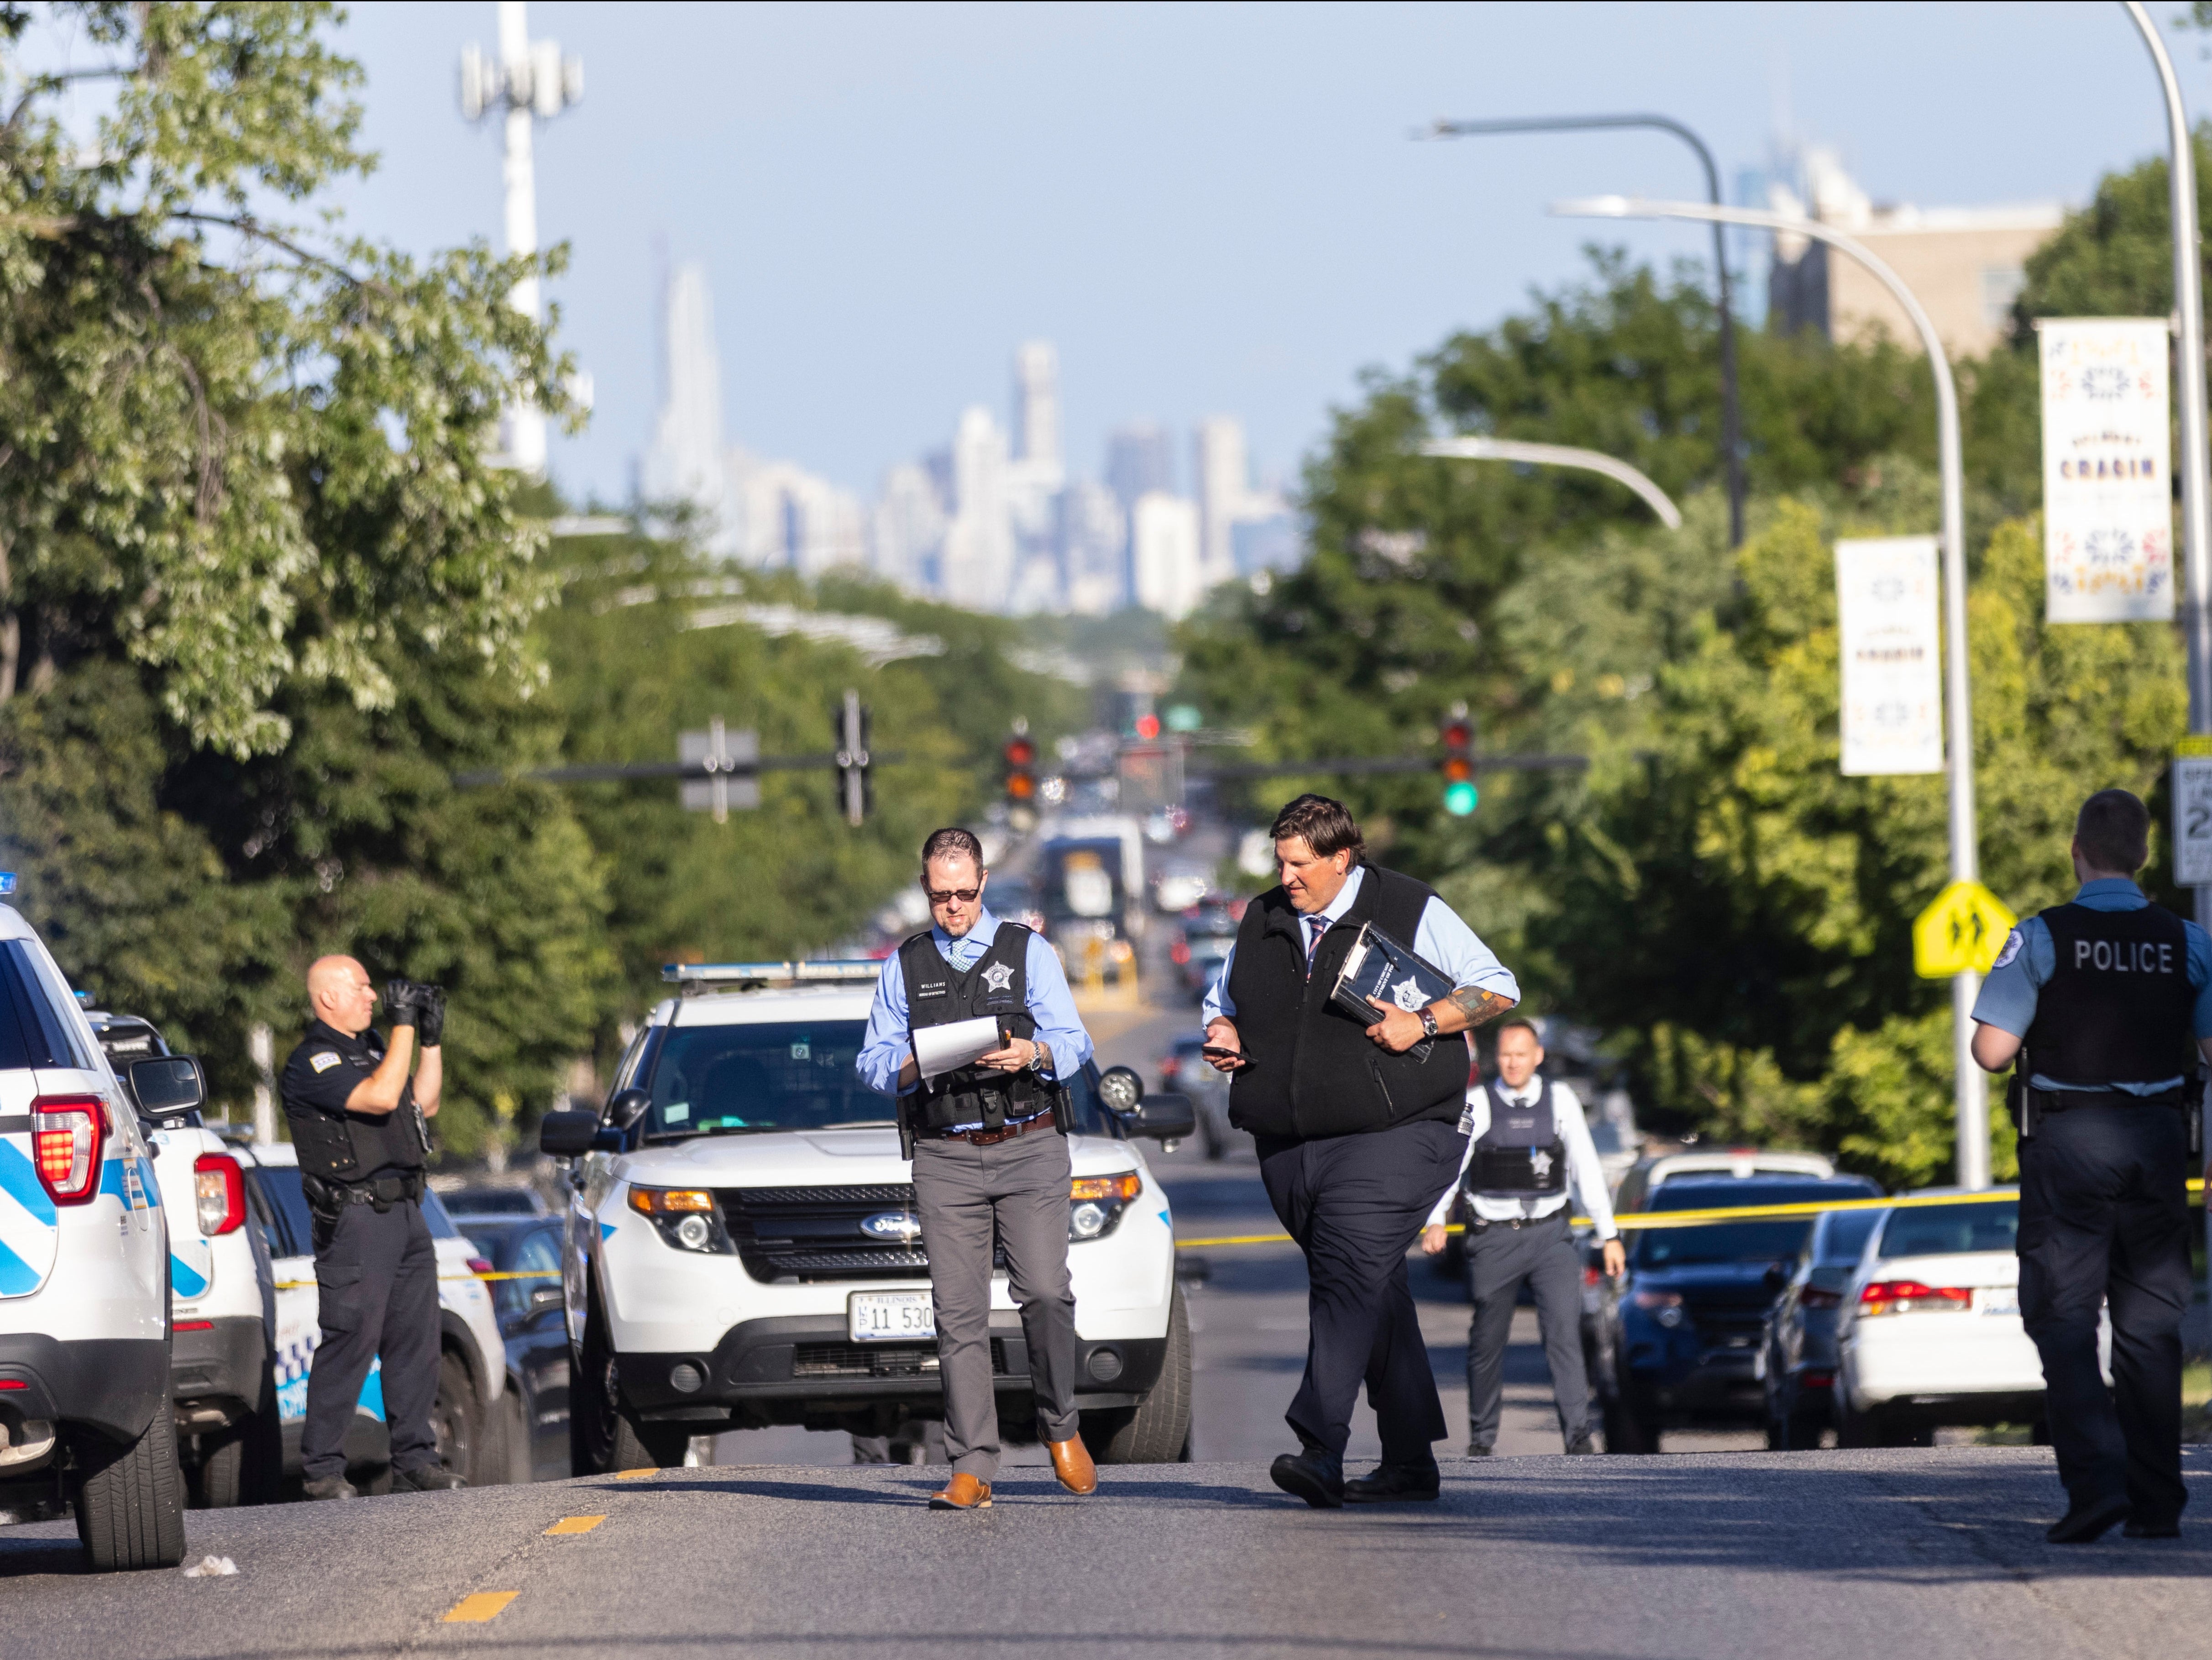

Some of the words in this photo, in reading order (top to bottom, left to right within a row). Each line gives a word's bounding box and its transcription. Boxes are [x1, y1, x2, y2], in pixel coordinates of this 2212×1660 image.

[2074, 940, 2173, 974] POLICE
[1380, 962, 1390, 980] CHICAGO
[871, 1308, 891, 1330] 11
